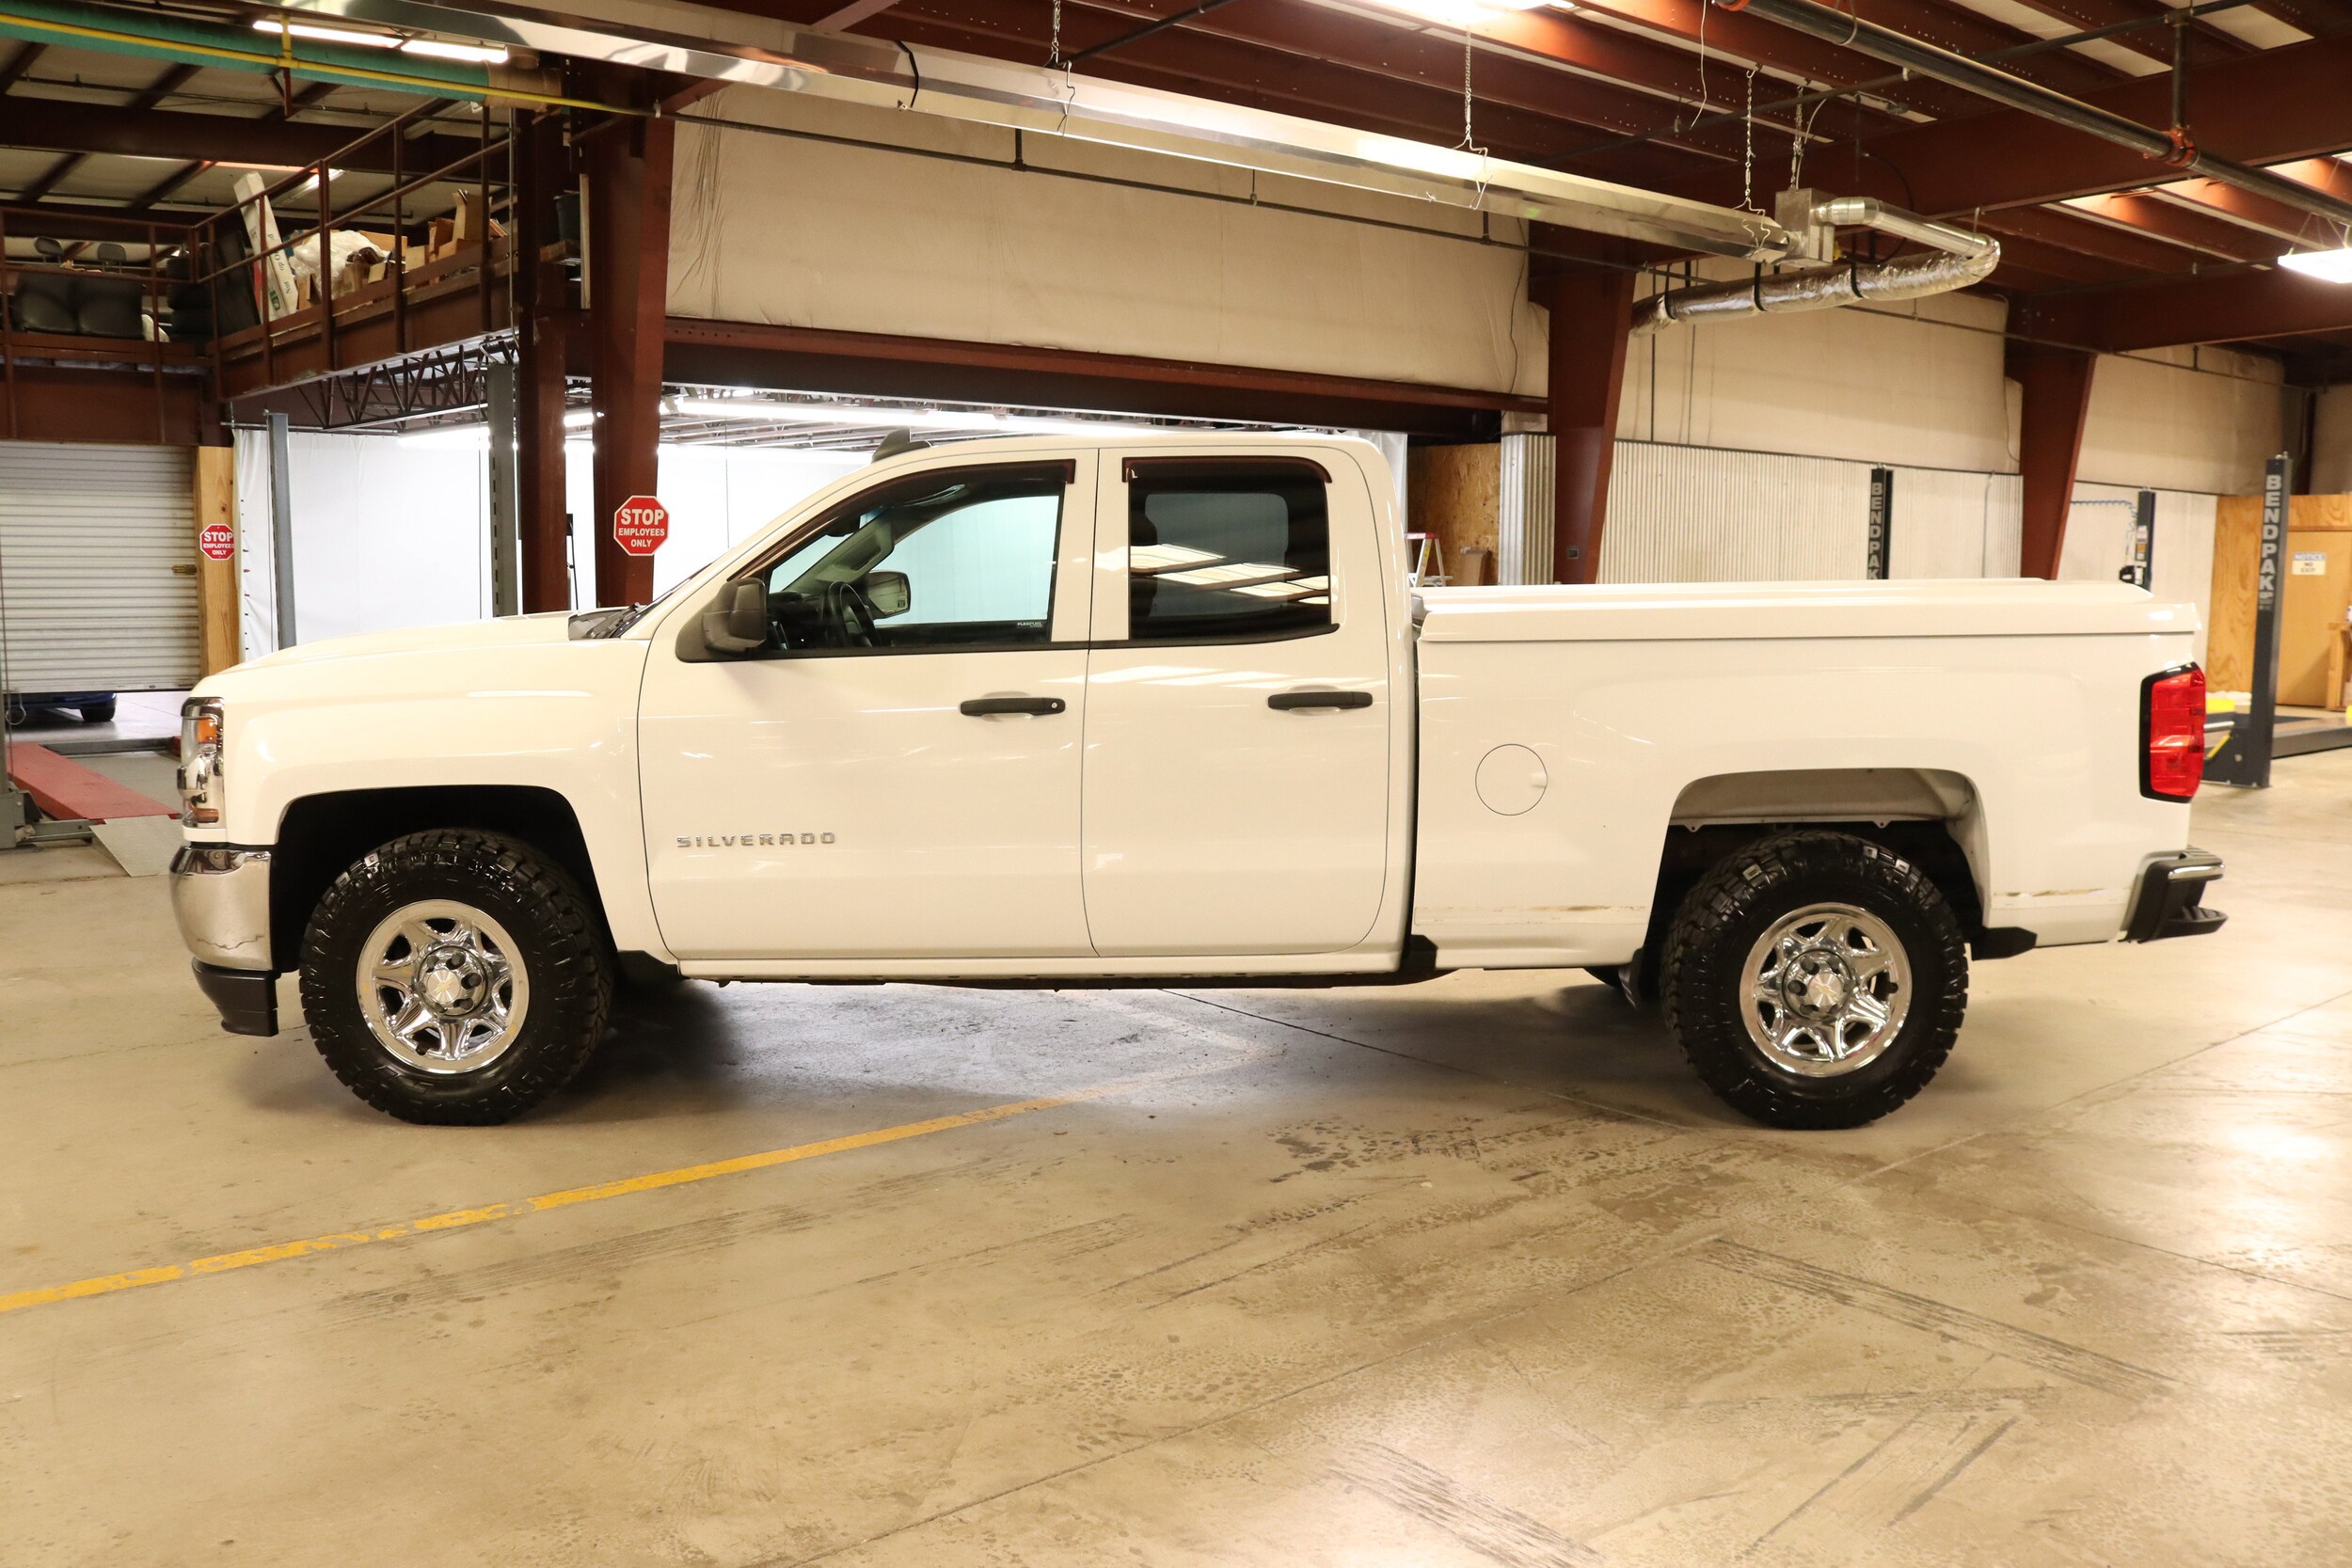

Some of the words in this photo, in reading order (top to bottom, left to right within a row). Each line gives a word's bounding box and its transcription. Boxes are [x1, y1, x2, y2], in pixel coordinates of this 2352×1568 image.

[620, 508, 665, 526] STOP
[203, 531, 233, 543] STOP
[618, 528, 665, 536] EMPLOYEES
[1867, 482, 1883, 580] BENDPAK
[2258, 474, 2281, 592] BENDPAK
[630, 539, 652, 547] ONLY
[676, 832, 835, 848] SILVERADO
